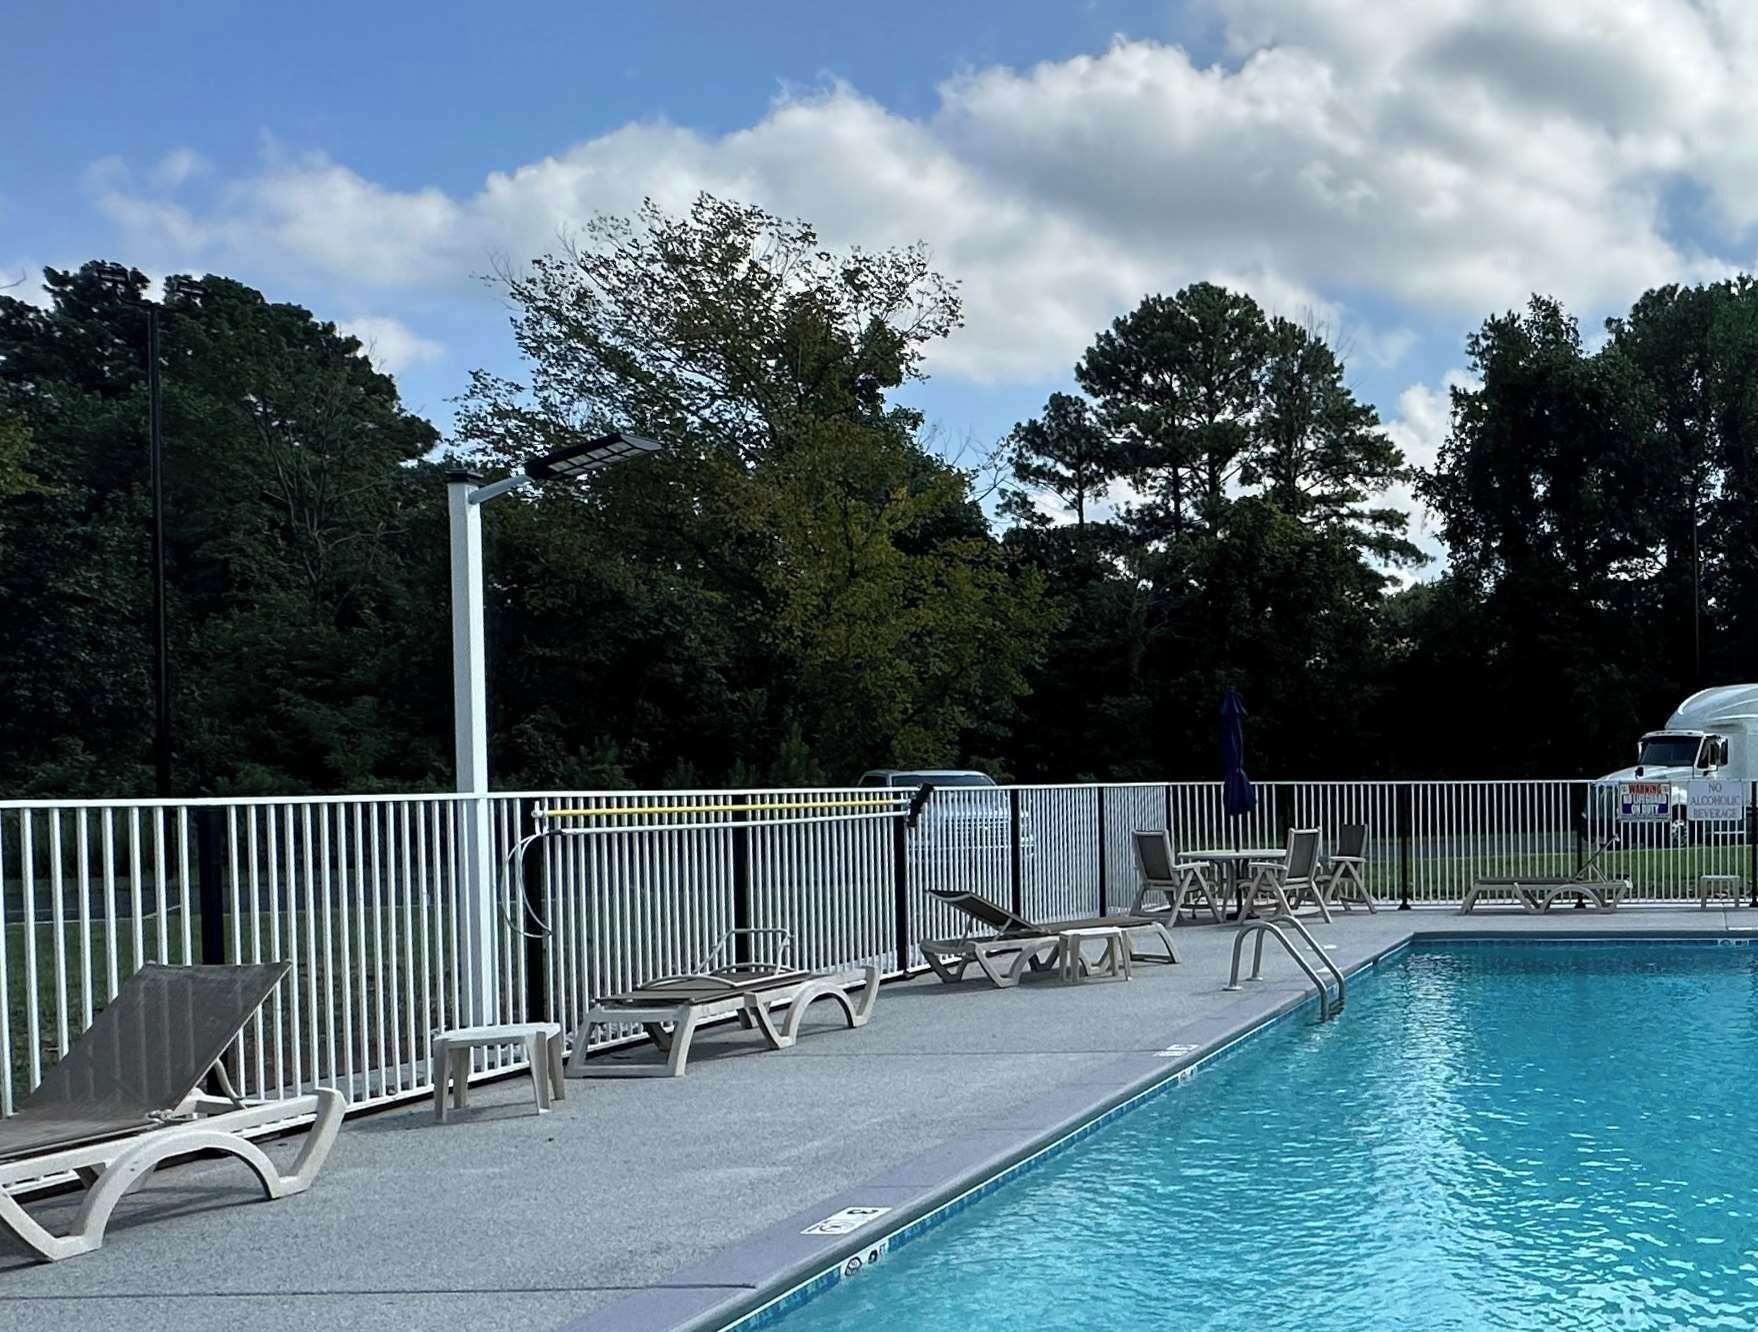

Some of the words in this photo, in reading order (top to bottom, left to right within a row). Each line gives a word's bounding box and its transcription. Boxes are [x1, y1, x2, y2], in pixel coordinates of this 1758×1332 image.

[1628, 783, 1662, 794] WARNING
[1708, 783, 1721, 793] NO
[1690, 795, 1741, 806] ALCOHOLIC
[1693, 807, 1738, 818] BEVERAGE
